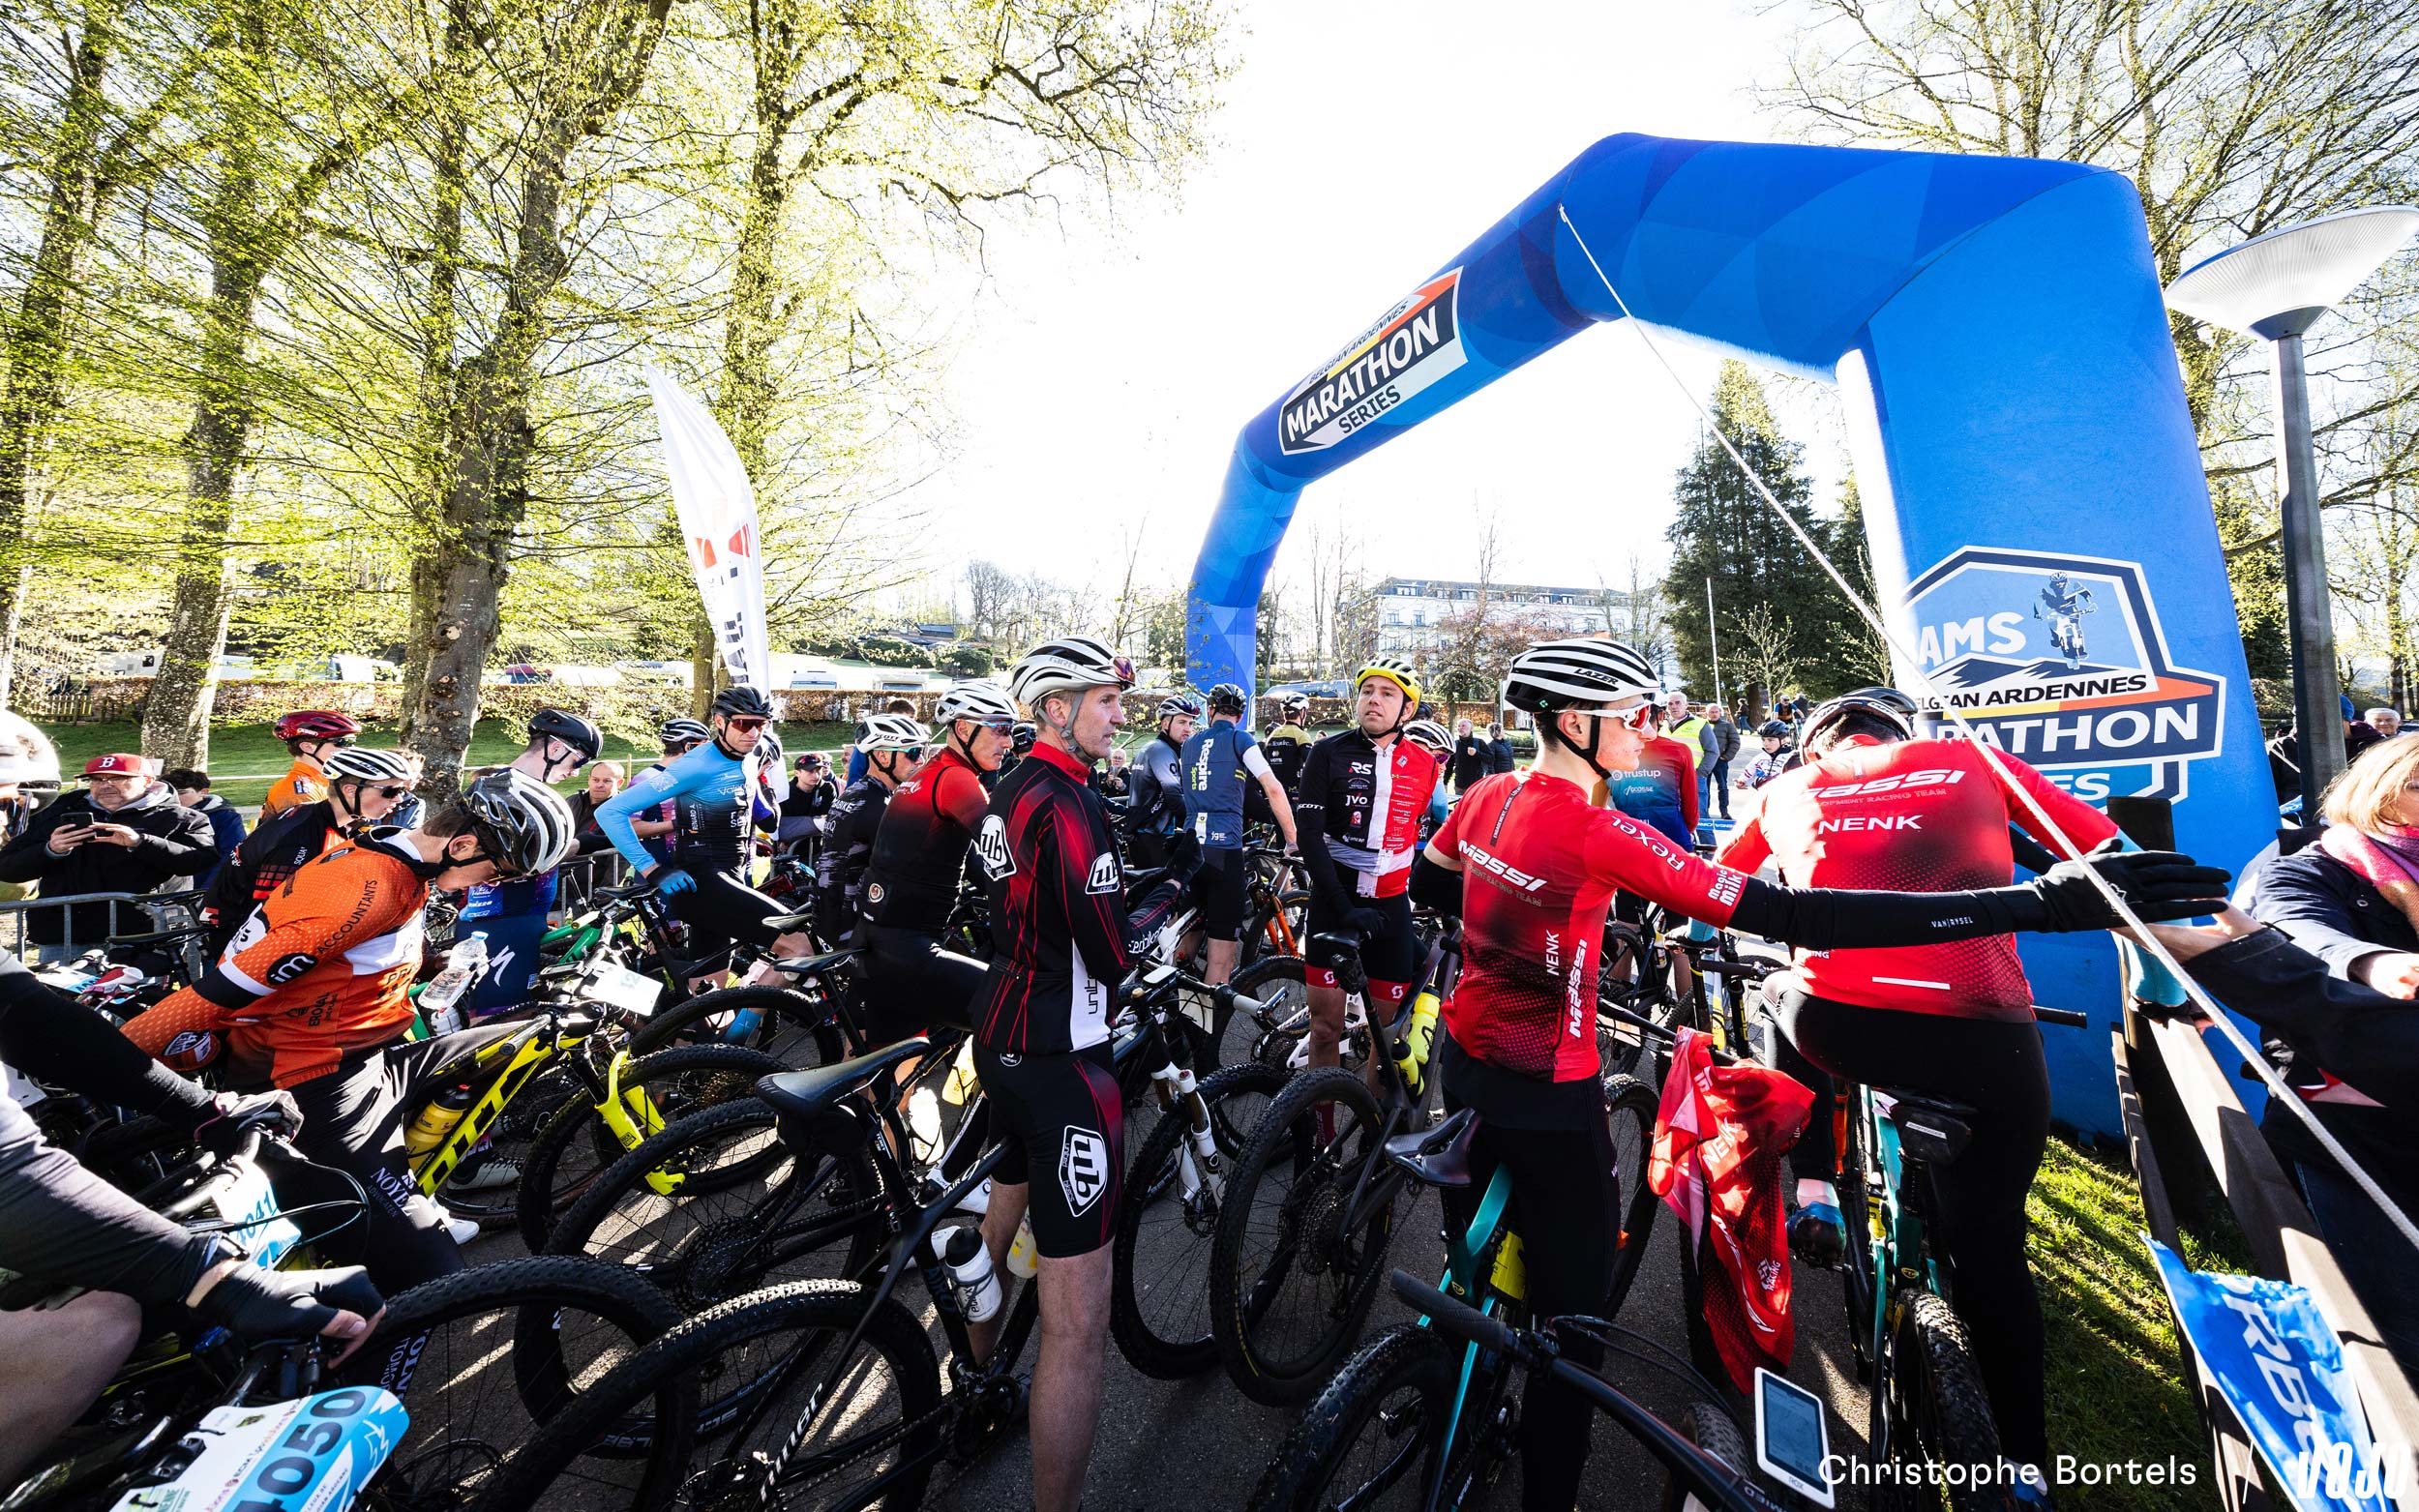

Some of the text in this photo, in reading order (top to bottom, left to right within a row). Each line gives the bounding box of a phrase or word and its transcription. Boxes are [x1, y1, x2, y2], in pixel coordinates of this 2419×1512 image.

[1308, 300, 1409, 384] BELGIAN ARDENNES
[1285, 305, 1441, 442] MARATHON
[1338, 384, 1401, 434] SERIES
[1918, 611, 2027, 667] AMS
[1048, 656, 1078, 669] GIRO
[1573, 667, 1619, 685] LAZER
[1986, 674, 2147, 706] ARDENNES
[1198, 738, 1214, 791] Respire
[1351, 761, 1373, 775] RS
[1624, 768, 1661, 779] trustup
[1345, 795, 1368, 807] JVO
[1866, 790, 1912, 804] RACING
[1913, 788, 1947, 798] TEAM
[1817, 815, 1926, 835] NENK
[1486, 874, 1542, 906] RACING TEAM
[1708, 868, 1728, 900] magic
[1718, 873, 1743, 906] milk
[316, 879, 378, 954] ACCOUNTANTS
[1545, 929, 1560, 976] NENK
[1701, 1116, 1739, 1171] NENK
[370, 1166, 411, 1217] NOYEZ
[235, 1190, 275, 1244] 4041
[232, 1389, 367, 1512] 4050
